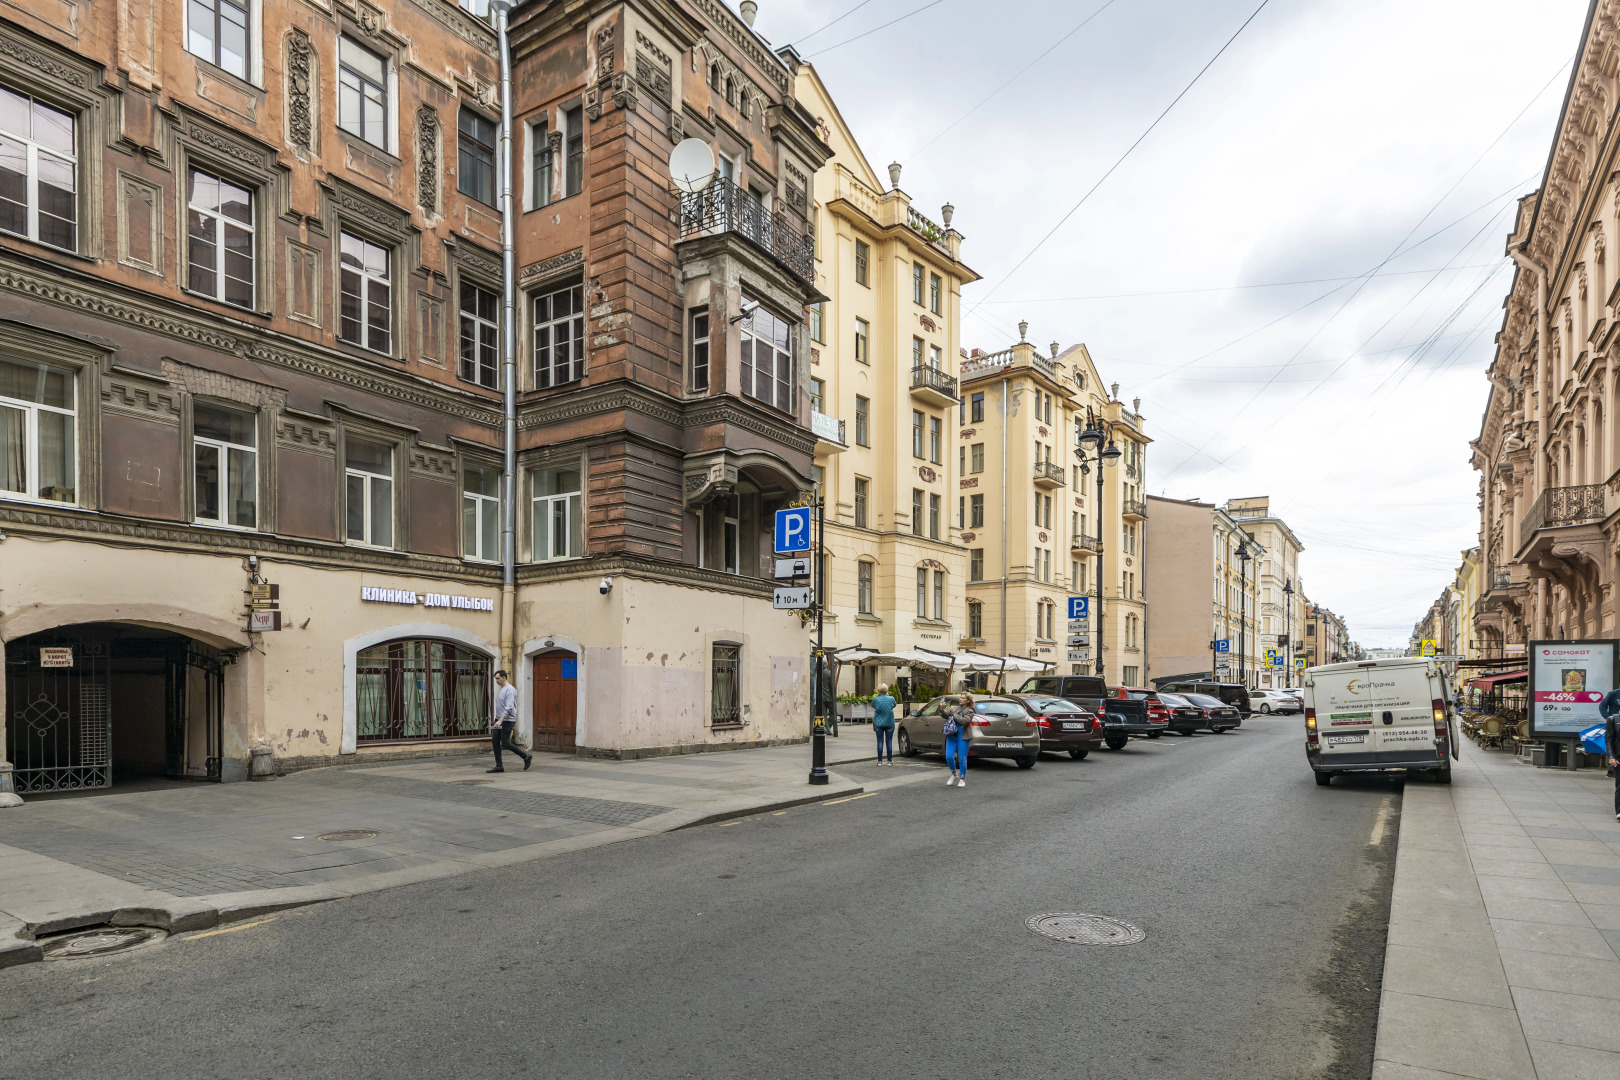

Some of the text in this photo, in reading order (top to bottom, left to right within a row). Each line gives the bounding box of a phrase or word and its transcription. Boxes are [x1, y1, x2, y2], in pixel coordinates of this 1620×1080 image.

[785, 513, 804, 547] P
[361, 586, 494, 611] КЛИНИКА ДОМ УЛЫБОК
[1073, 599, 1085, 617] P
[1219, 641, 1227, 651] P
[1543, 693, 1576, 701] -46%
